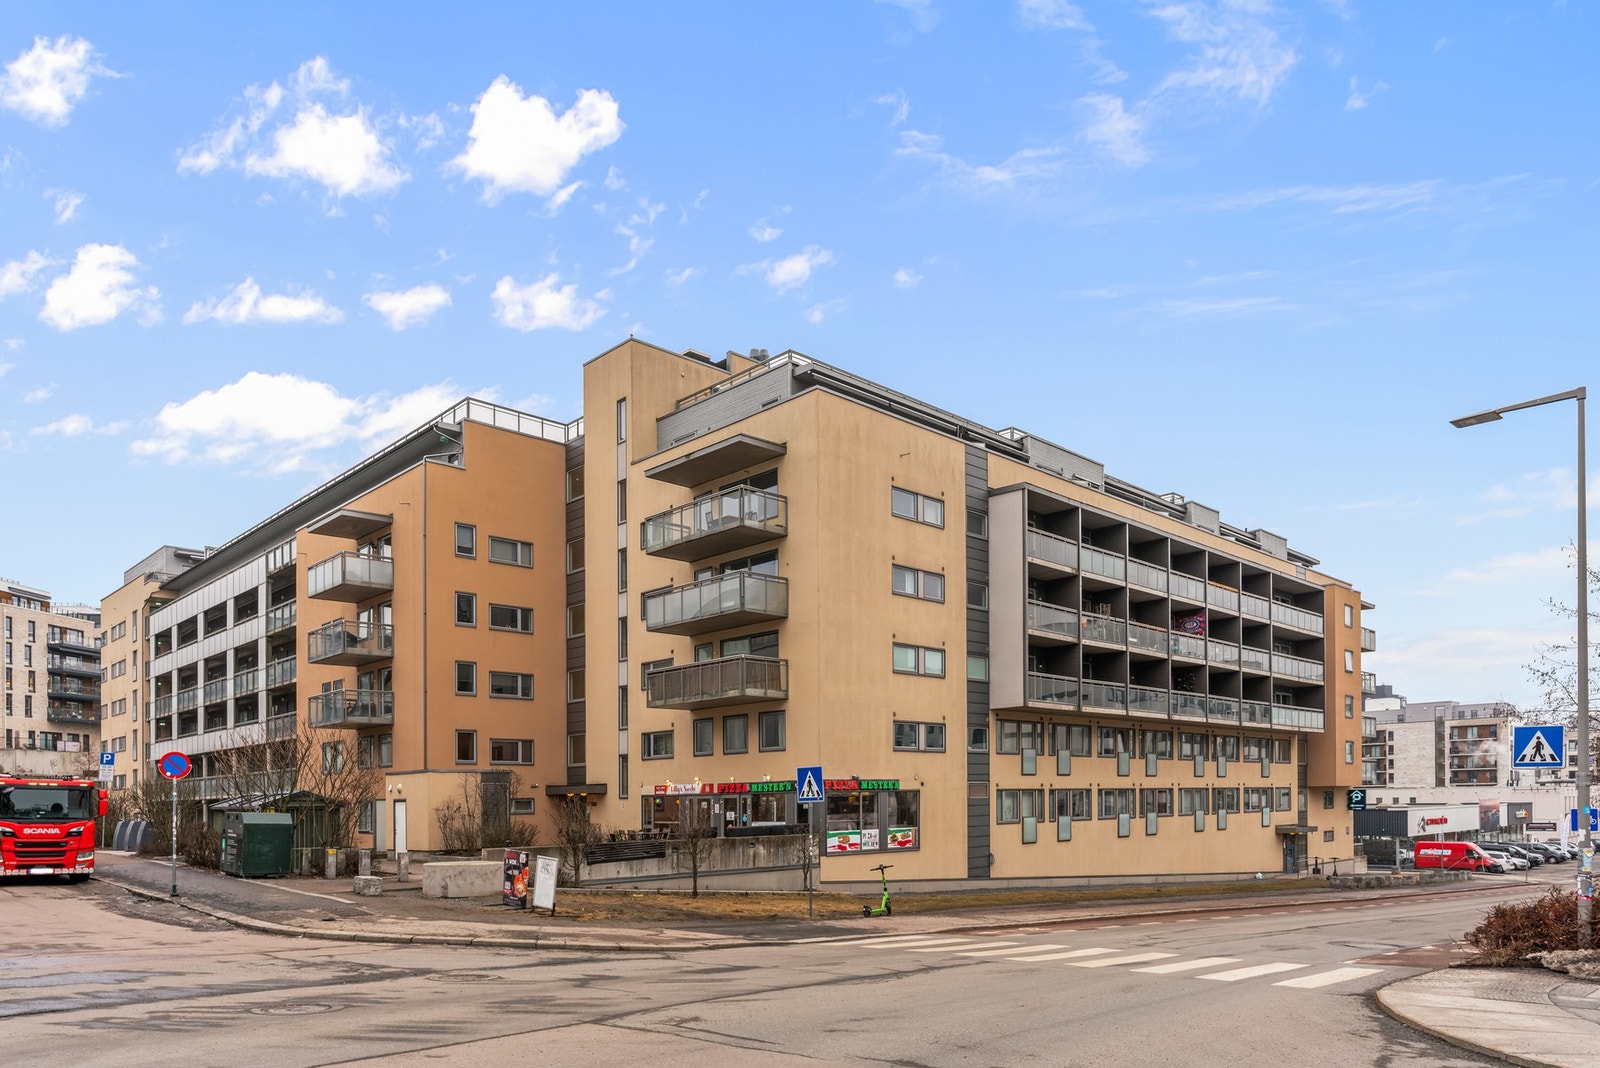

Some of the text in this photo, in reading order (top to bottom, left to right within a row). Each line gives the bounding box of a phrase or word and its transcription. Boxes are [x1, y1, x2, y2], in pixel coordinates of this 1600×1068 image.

[103, 754, 111, 763] P
[717, 783, 749, 793] PIZZA
[824, 780, 858, 790] PIZZA
[23, 827, 60, 835] SCANIA
